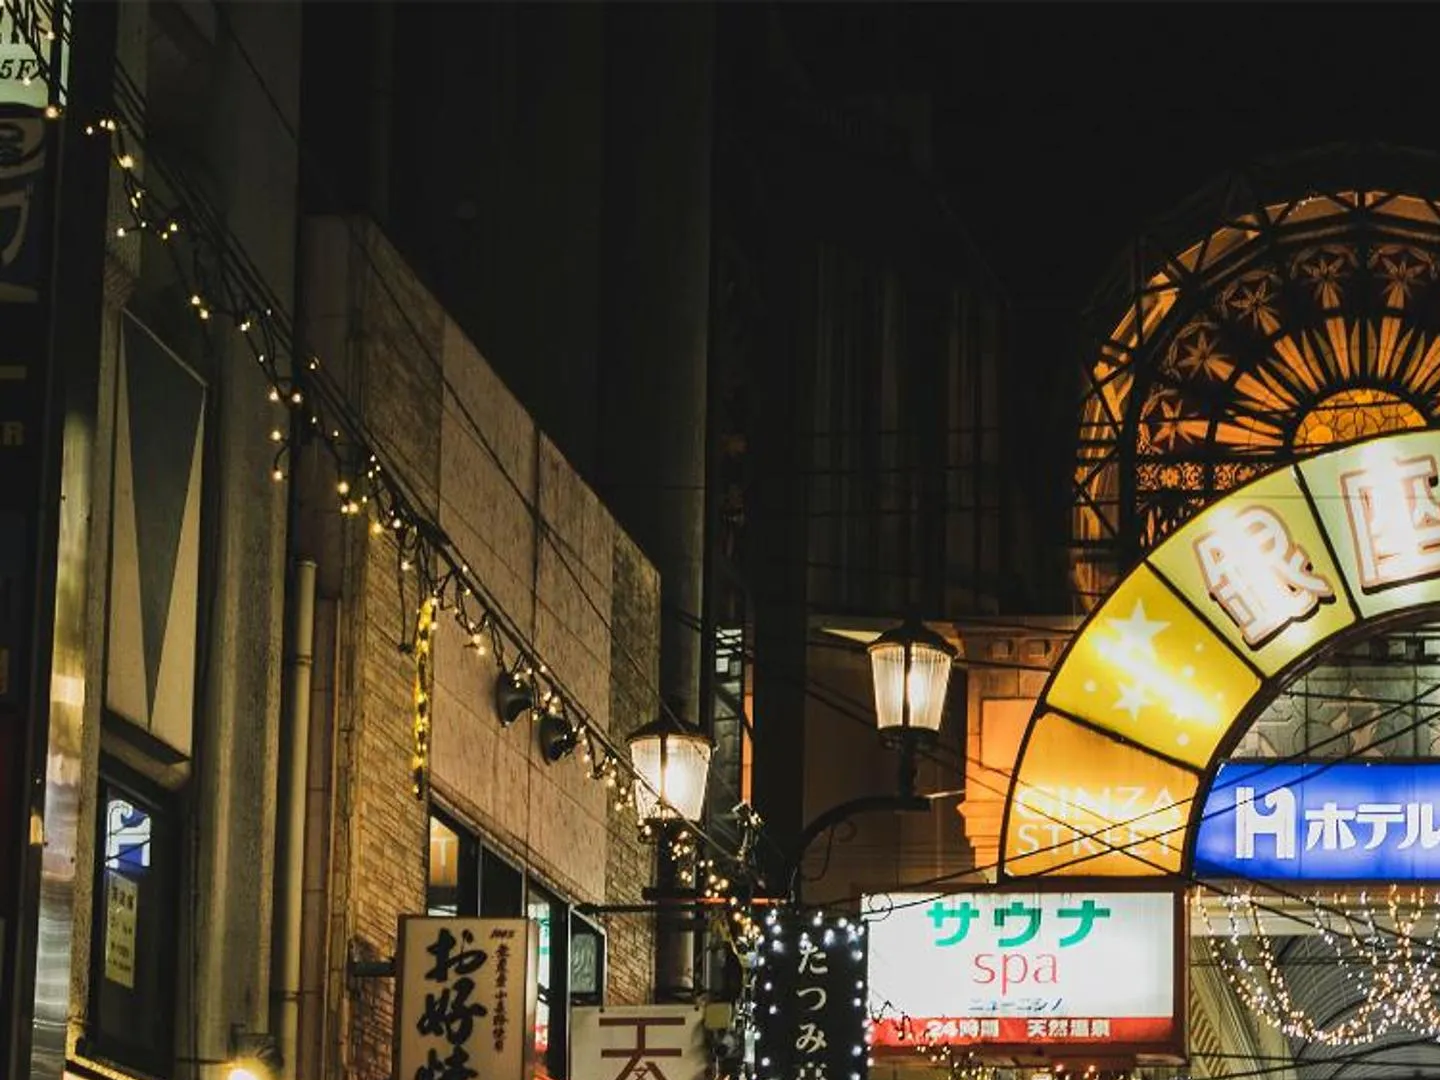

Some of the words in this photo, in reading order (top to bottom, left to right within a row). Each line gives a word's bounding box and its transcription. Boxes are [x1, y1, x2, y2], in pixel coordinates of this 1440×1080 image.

[927, 900, 1111, 948] サウナ
[973, 951, 1061, 996] spa
[926, 1018, 1000, 1038] 24時間
[1027, 1018, 1111, 1038] 天然温泉
